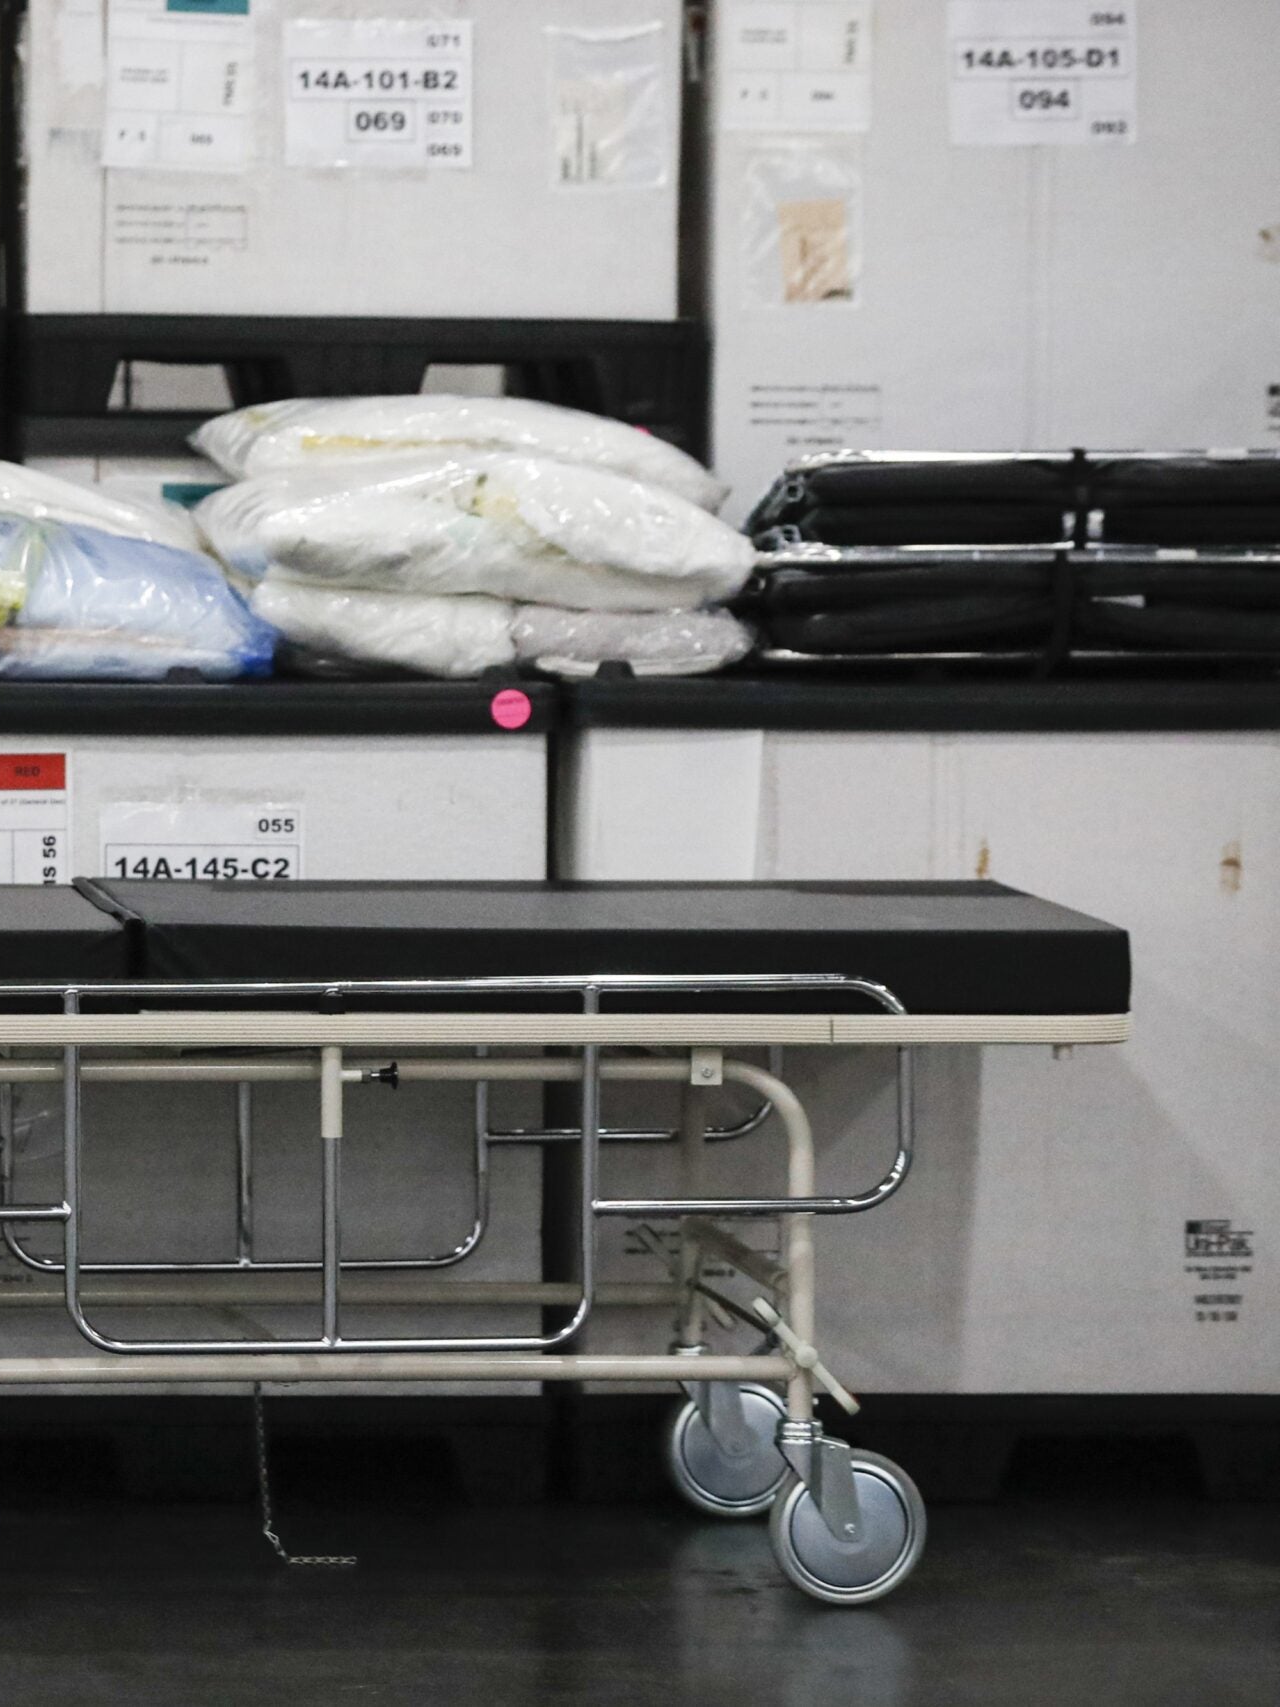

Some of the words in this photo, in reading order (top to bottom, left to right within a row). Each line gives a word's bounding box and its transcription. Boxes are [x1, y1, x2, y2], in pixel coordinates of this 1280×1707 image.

[963, 48, 1120, 68] 14A-105-D1
[298, 69, 458, 90] 14A-101-B2
[1019, 90, 1070, 109] 094
[355, 111, 406, 131] 069
[14, 766, 41, 777] RED
[257, 818, 295, 833] 055
[42, 835, 57, 858] 56
[114, 856, 291, 880] 14A-145-C2
